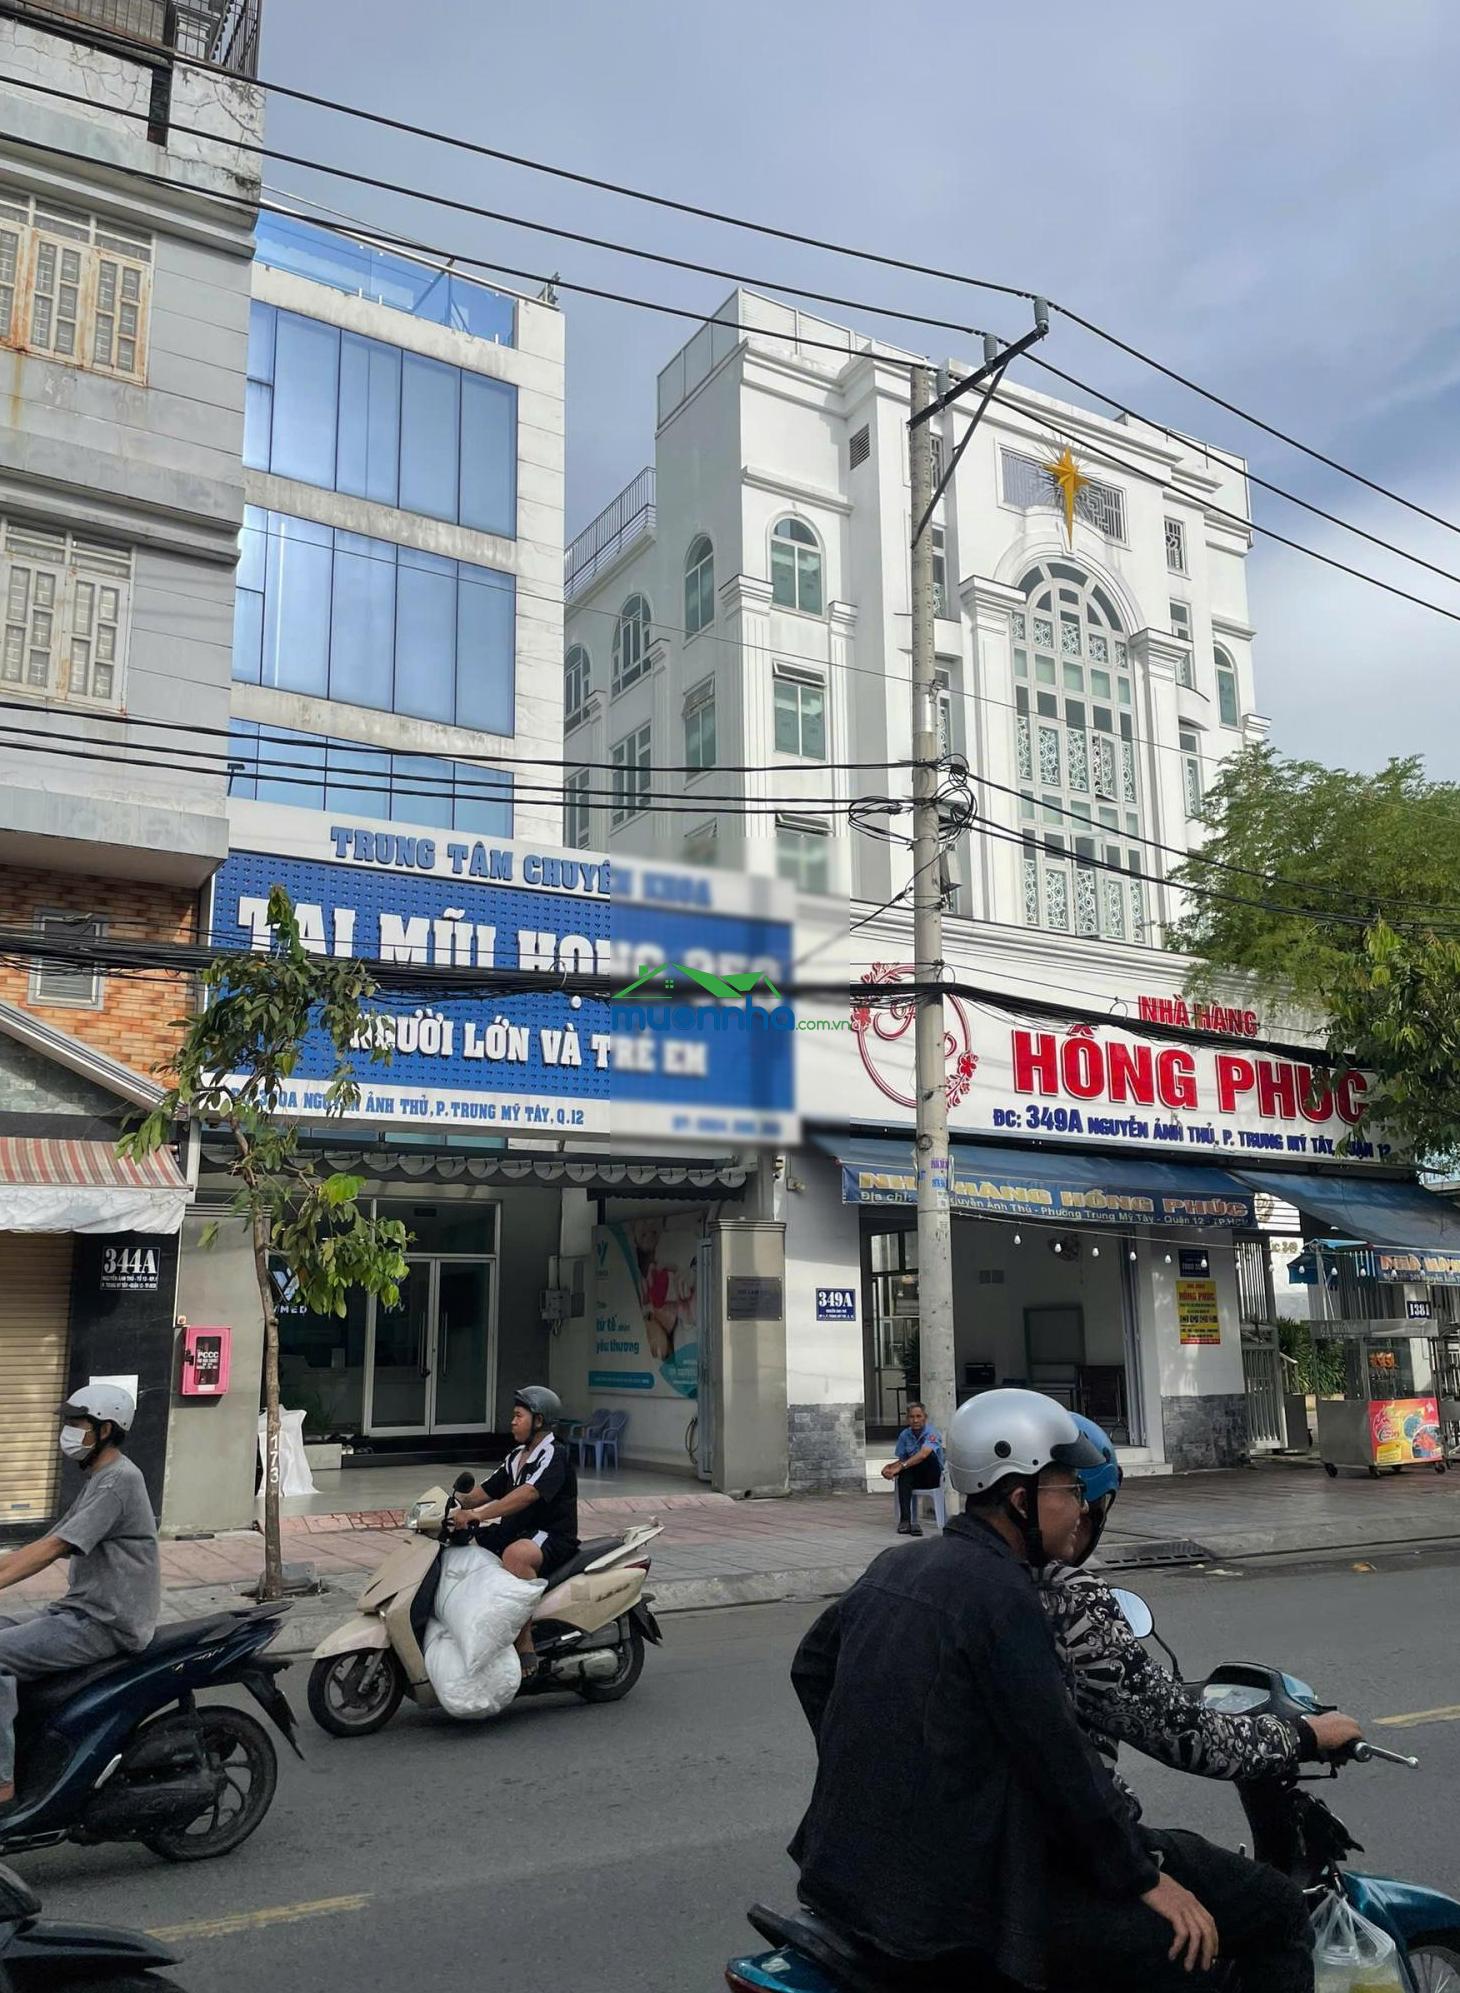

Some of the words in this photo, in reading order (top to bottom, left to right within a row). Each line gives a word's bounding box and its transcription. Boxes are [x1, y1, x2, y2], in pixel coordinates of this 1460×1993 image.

[330, 826, 436, 869] TRUNG
[447, 841, 514, 881] TÂM
[1138, 993, 1191, 1027] NHÀ
[1193, 1000, 1258, 1038] HÀNG
[463, 1015, 530, 1061] LỚN
[540, 1022, 582, 1066] VÀ
[366, 1091, 395, 1114] ẢNH
[450, 1101, 496, 1120] TRUNG
[1025, 1104, 1084, 1133] 349A
[1238, 1131, 1284, 1150] TRUNG
[859, 1171, 917, 1190] NH
[104, 1248, 157, 1274] 344A
[818, 1291, 853, 1307] 349A
